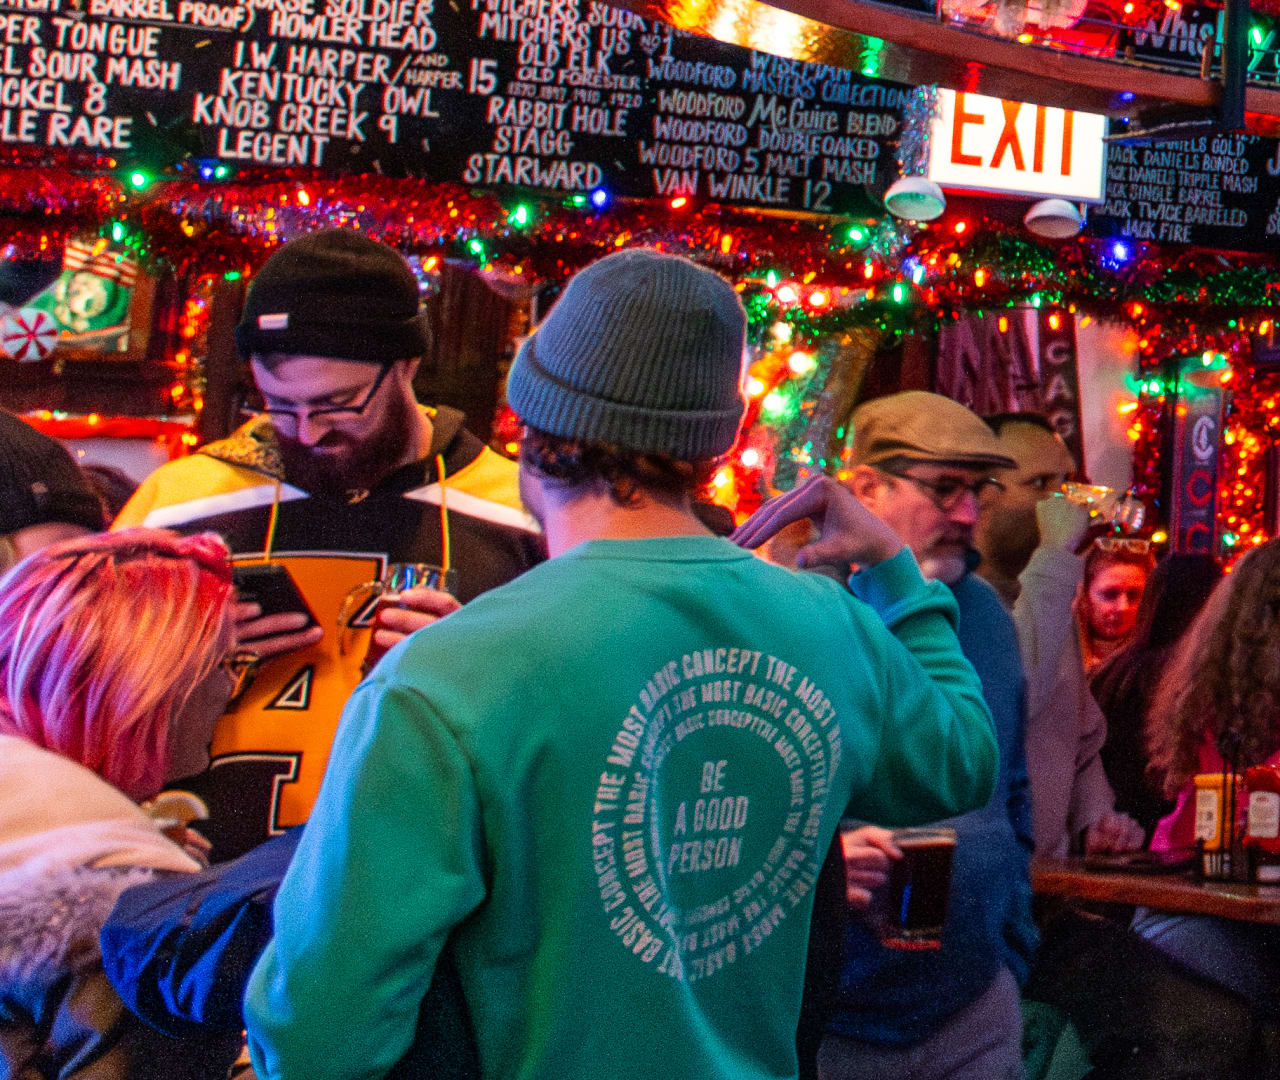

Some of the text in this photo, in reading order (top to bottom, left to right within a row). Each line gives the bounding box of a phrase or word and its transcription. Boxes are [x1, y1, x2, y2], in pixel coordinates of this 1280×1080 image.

[177, 0, 256, 30] PROOF)
[269, 10, 438, 52] HOWLER HEAD
[478, 11, 592, 51] MITCHERS
[602, 27, 631, 55] US
[51, 17, 161, 58] TONGUE
[27, 46, 183, 91] SOUR MASH
[412, 54, 449, 68] AND
[467, 57, 499, 96] 15
[515, 66, 555, 83] OLD
[516, 42, 612, 76] OLD ELK
[647, 57, 737, 90] WOODFORD
[83, 82, 108, 115] 8
[218, 68, 440, 118] KENTUCKY OWL
[404, 69, 464, 90] HARPER
[47, 111, 133, 149] RARE
[192, 92, 399, 144] KNOB CREEK 9
[486, 95, 629, 137] RABBIT HOLE
[654, 115, 748, 147] WOODFORD
[658, 88, 899, 136] WOODFORD McGuire BLEND
[217, 127, 331, 167] LEGENT
[491, 124, 575, 156] STAGG
[462, 152, 602, 191] STARWARD
[638, 140, 876, 185] WOODFORD 5 MALT MASH
[1128, 166, 1177, 185] DANIELS
[1222, 174, 1258, 193] MASH
[1143, 150, 1200, 170] DANIELS
[1202, 155, 1249, 175] BONDED
[652, 168, 832, 211] VAN WINKLE 12
[1177, 187, 1223, 208] BARREL
[1122, 219, 1193, 243] JACK FIRE
[1137, 202, 1248, 227] TWICE BARRELED
[700, 681, 741, 704] MOST
[745, 685, 785, 722] BASIC
[702, 760, 727, 793] BE
[593, 648, 834, 962] BASIC CONCEPT THE MOST BASIC CONCEPT THE MOST
[674, 796, 749, 835] A GOOD
[668, 838, 742, 874] PERSON
